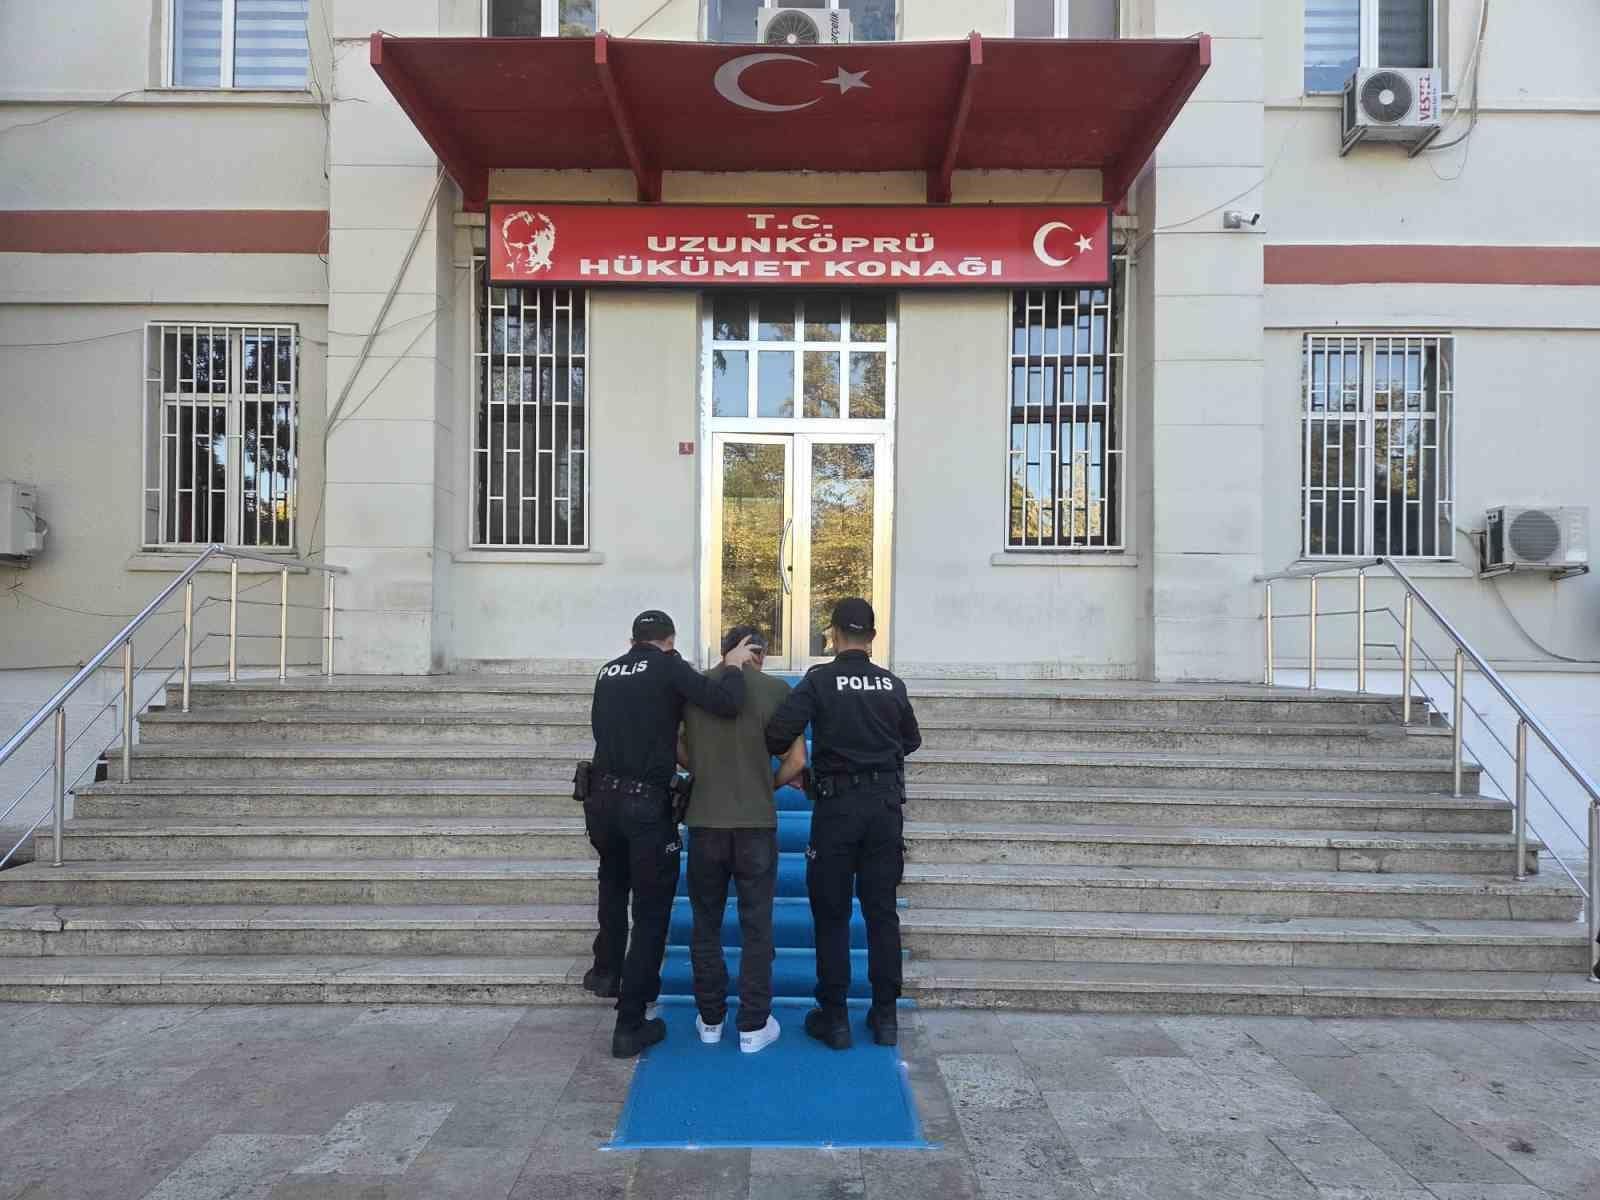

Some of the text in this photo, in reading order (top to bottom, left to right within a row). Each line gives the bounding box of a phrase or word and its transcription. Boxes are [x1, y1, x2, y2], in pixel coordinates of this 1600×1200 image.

[1419, 73, 1431, 121] VESTEL
[747, 214, 833, 230] T.C.
[647, 233, 935, 252] UZUNKÖPRÜ
[579, 255, 1002, 277] HÜKÜMET KONAĞI
